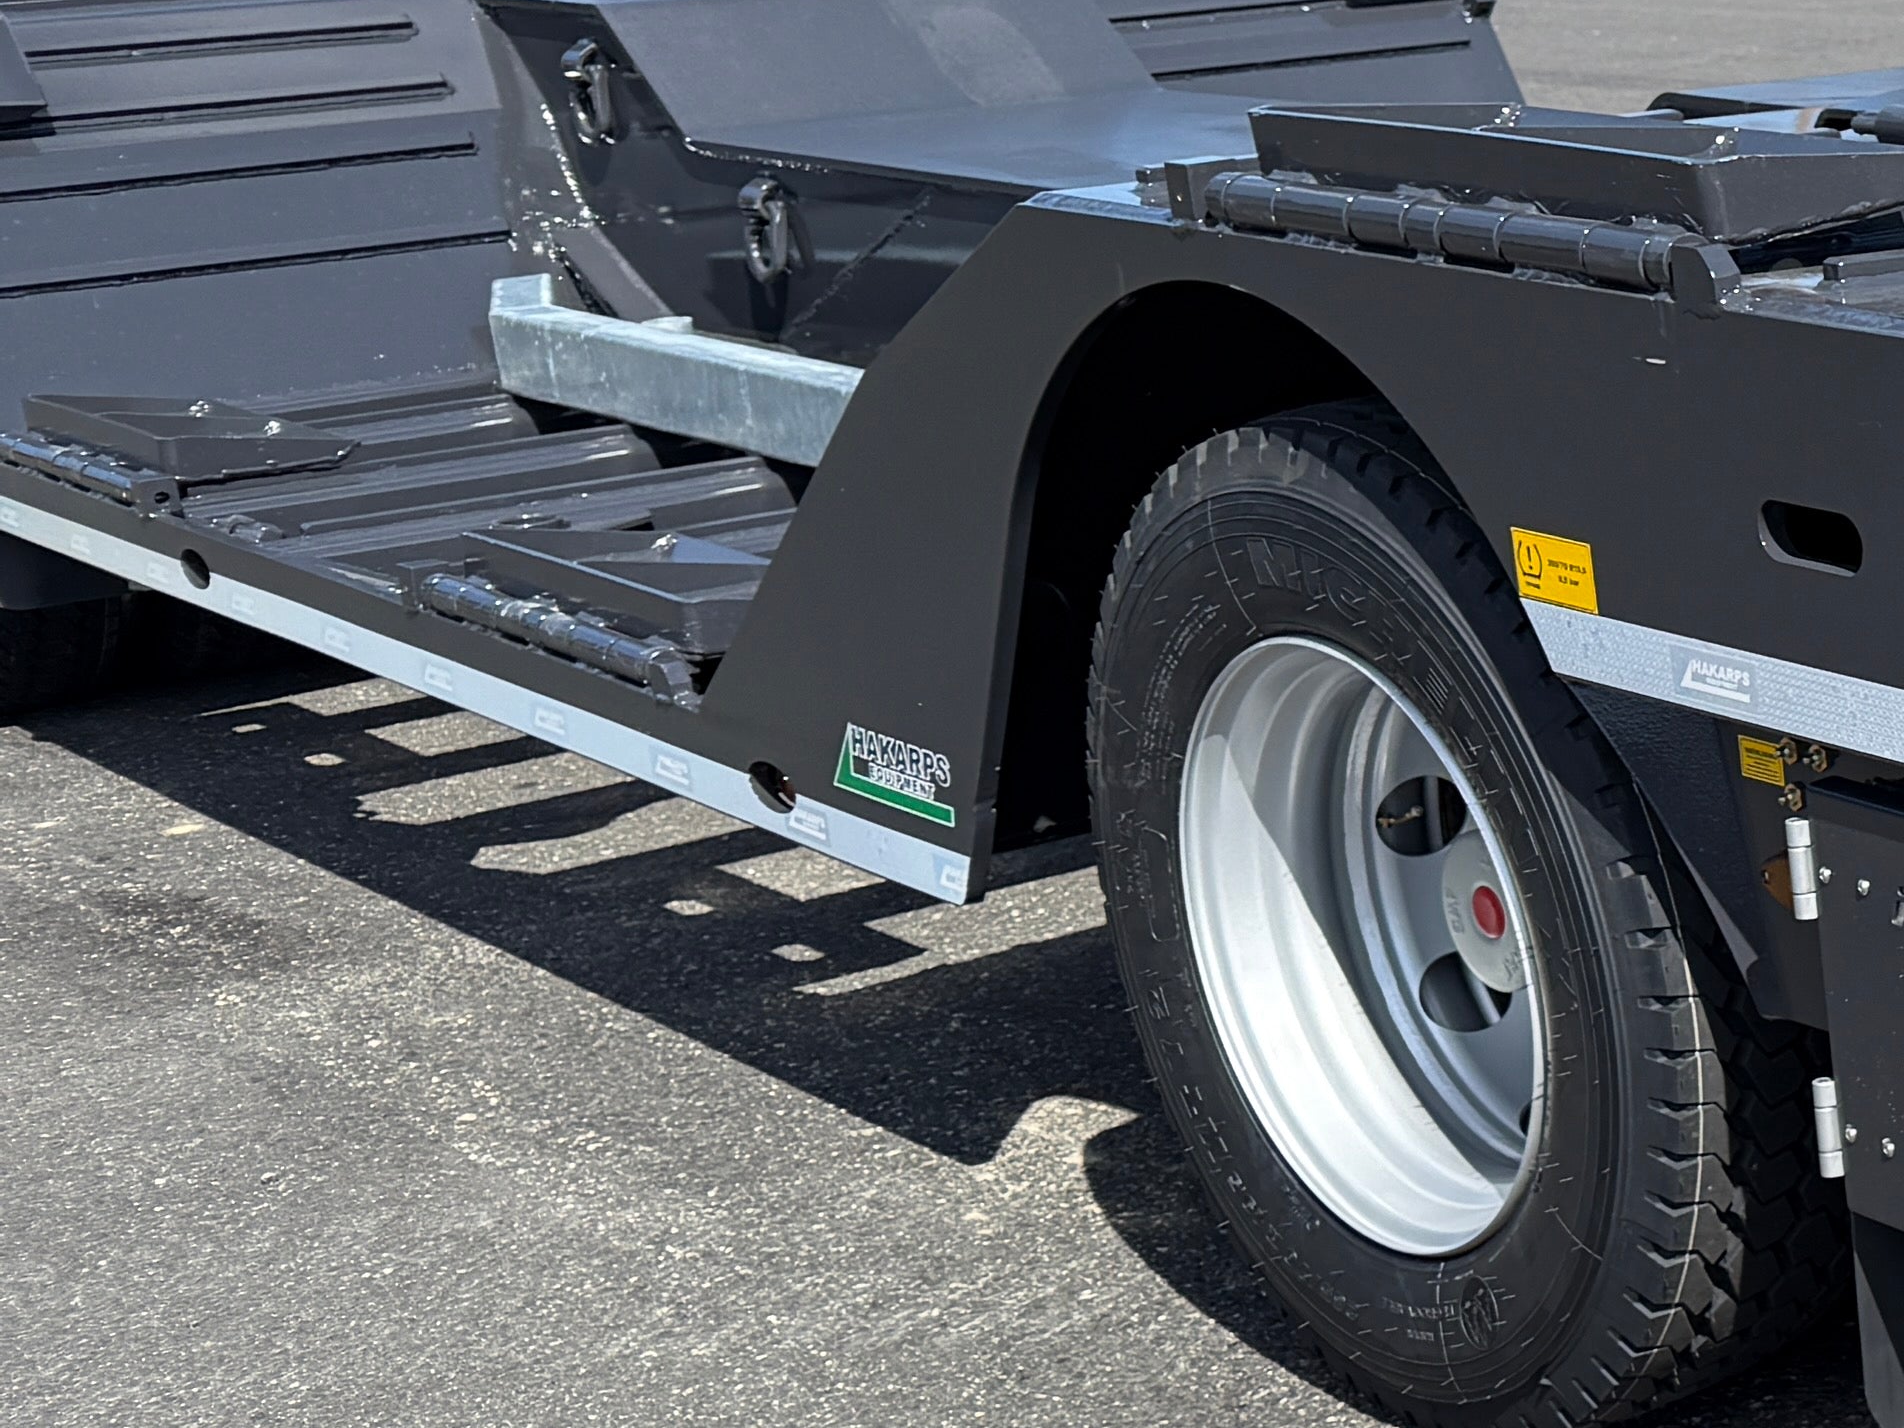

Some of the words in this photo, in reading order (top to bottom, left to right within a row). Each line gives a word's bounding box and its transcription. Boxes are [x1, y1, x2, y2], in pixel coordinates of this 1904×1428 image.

[1691, 659, 1750, 687] HAKARPS
[849, 724, 951, 787] HAKARPS
[868, 762, 935, 801] EQUIPMENT
